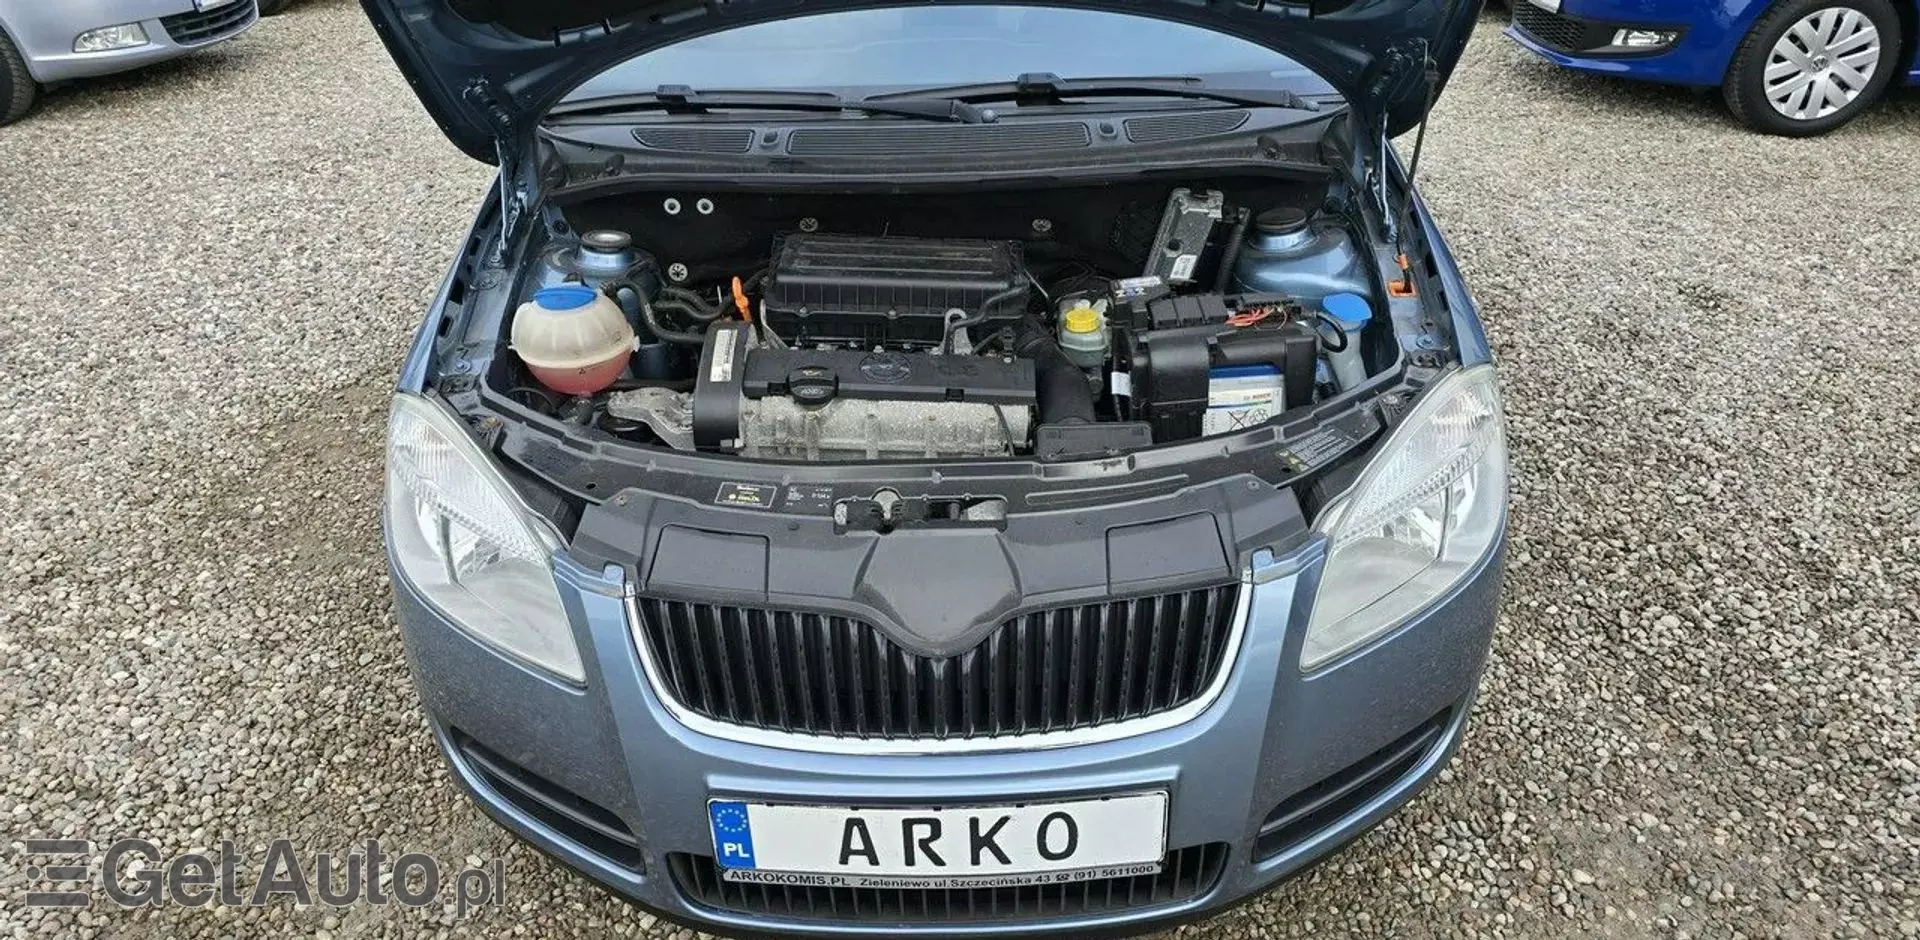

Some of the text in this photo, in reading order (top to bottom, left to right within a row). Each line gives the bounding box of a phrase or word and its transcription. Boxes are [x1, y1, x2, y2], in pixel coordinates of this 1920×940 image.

[723, 842, 750, 859] PL
[838, 810, 1079, 867] ARKO
[730, 870, 851, 887] ARKOKOMIS.PL
[859, 877, 931, 889] Zieleniewo
[1035, 875, 1050, 883] 43
[1073, 869, 1097, 880] (91)
[1101, 865, 1154, 877] 5611000
